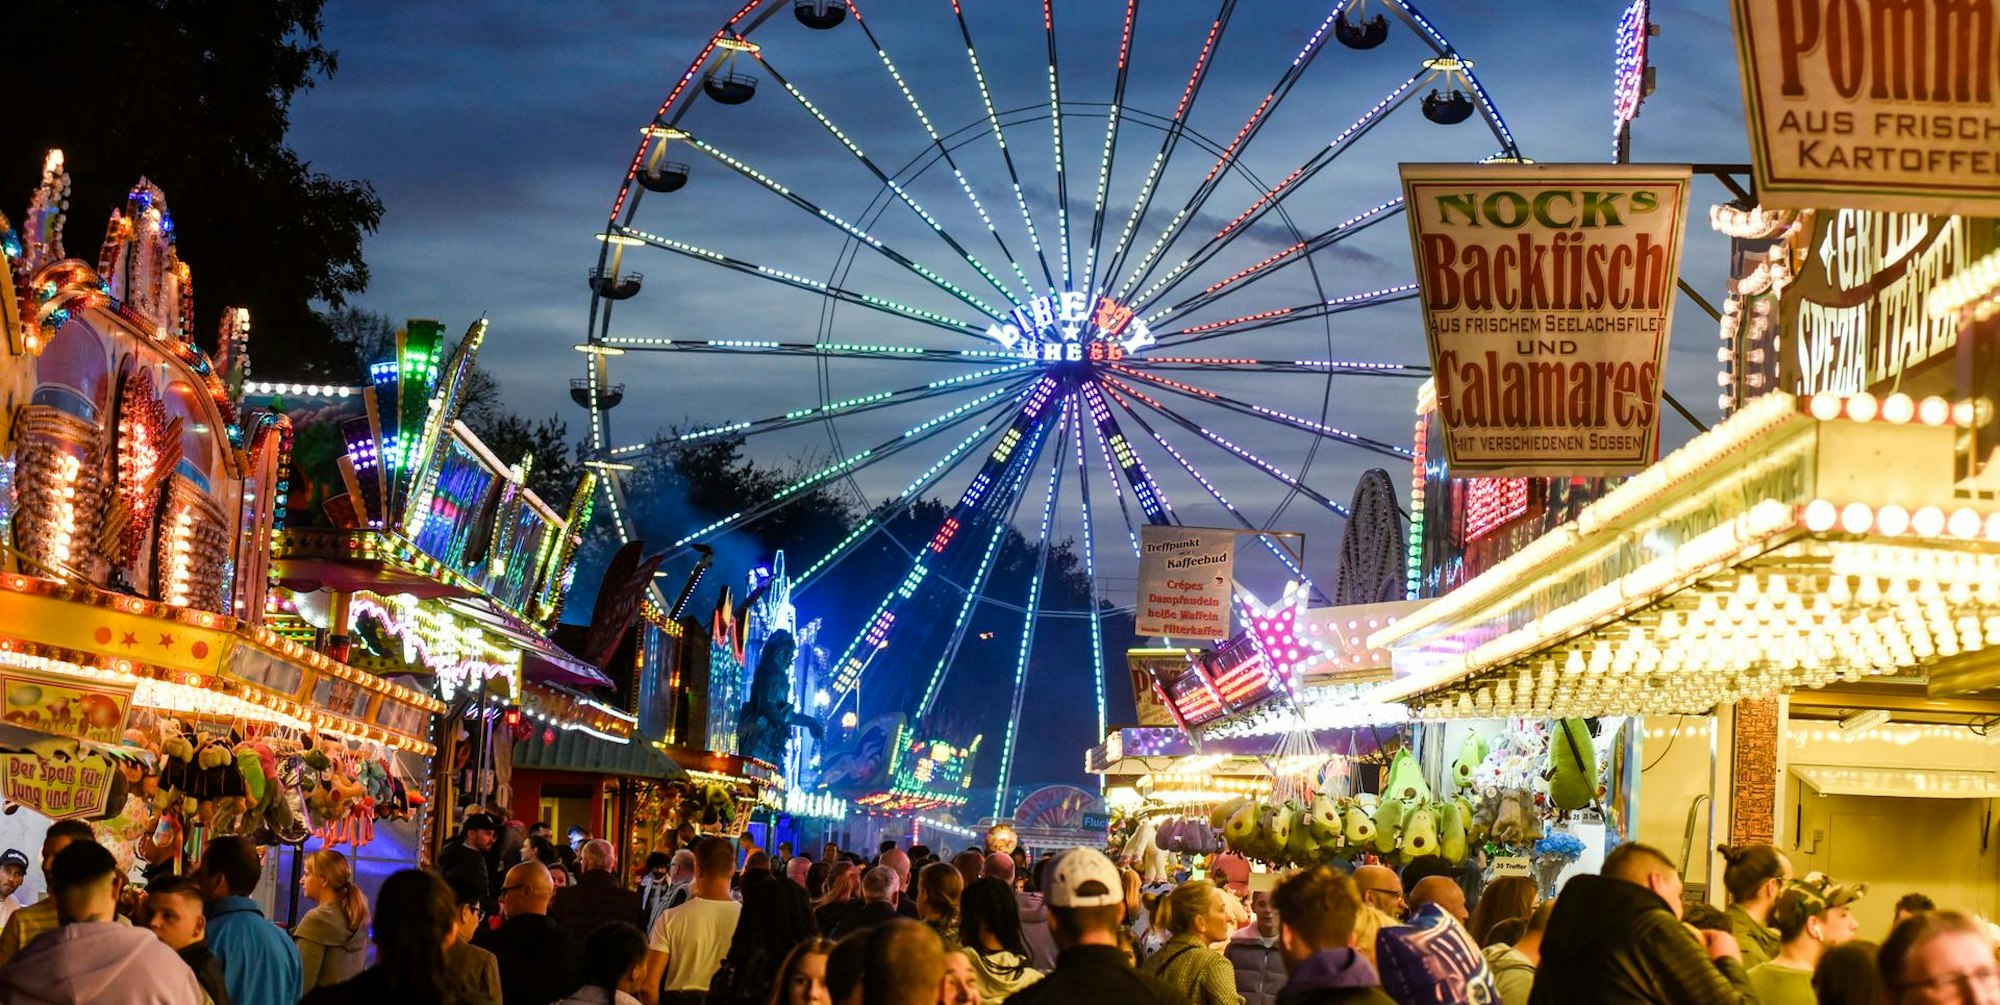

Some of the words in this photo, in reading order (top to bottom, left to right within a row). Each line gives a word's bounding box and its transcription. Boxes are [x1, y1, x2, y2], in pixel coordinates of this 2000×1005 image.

[1777, 0, 2000, 103] Pomm
[1779, 110, 1854, 134] AUS
[1420, 231, 1665, 312] Backfisch
[986, 291, 1156, 354] LIBERTY
[1430, 317, 1460, 333] AUS
[1465, 317, 1541, 333] FRISCHEM
[1545, 315, 1667, 333] SEELACHSFILET
[1021, 342, 1123, 361] WHEEL
[1516, 340, 1578, 355] UND
[1437, 350, 1657, 431] Calamares
[1480, 434, 1583, 450] VERSCHIEDENEN
[1146, 539, 1200, 554] Treffpunkt
[1167, 553, 1227, 570] Kaffeebud
[1149, 594, 1219, 607] Dampfnudeln
[1148, 608, 1177, 620] heiße
[1180, 609, 1219, 621] Waffeln
[1163, 624, 1223, 637] Filterkaffee
[10, 757, 35, 778] Der
[40, 759, 75, 785] Spaß
[80, 766, 102, 788] für
[10, 778, 41, 806] Jung
[46, 785, 71, 809] und
[74, 788, 95, 809] Alt
